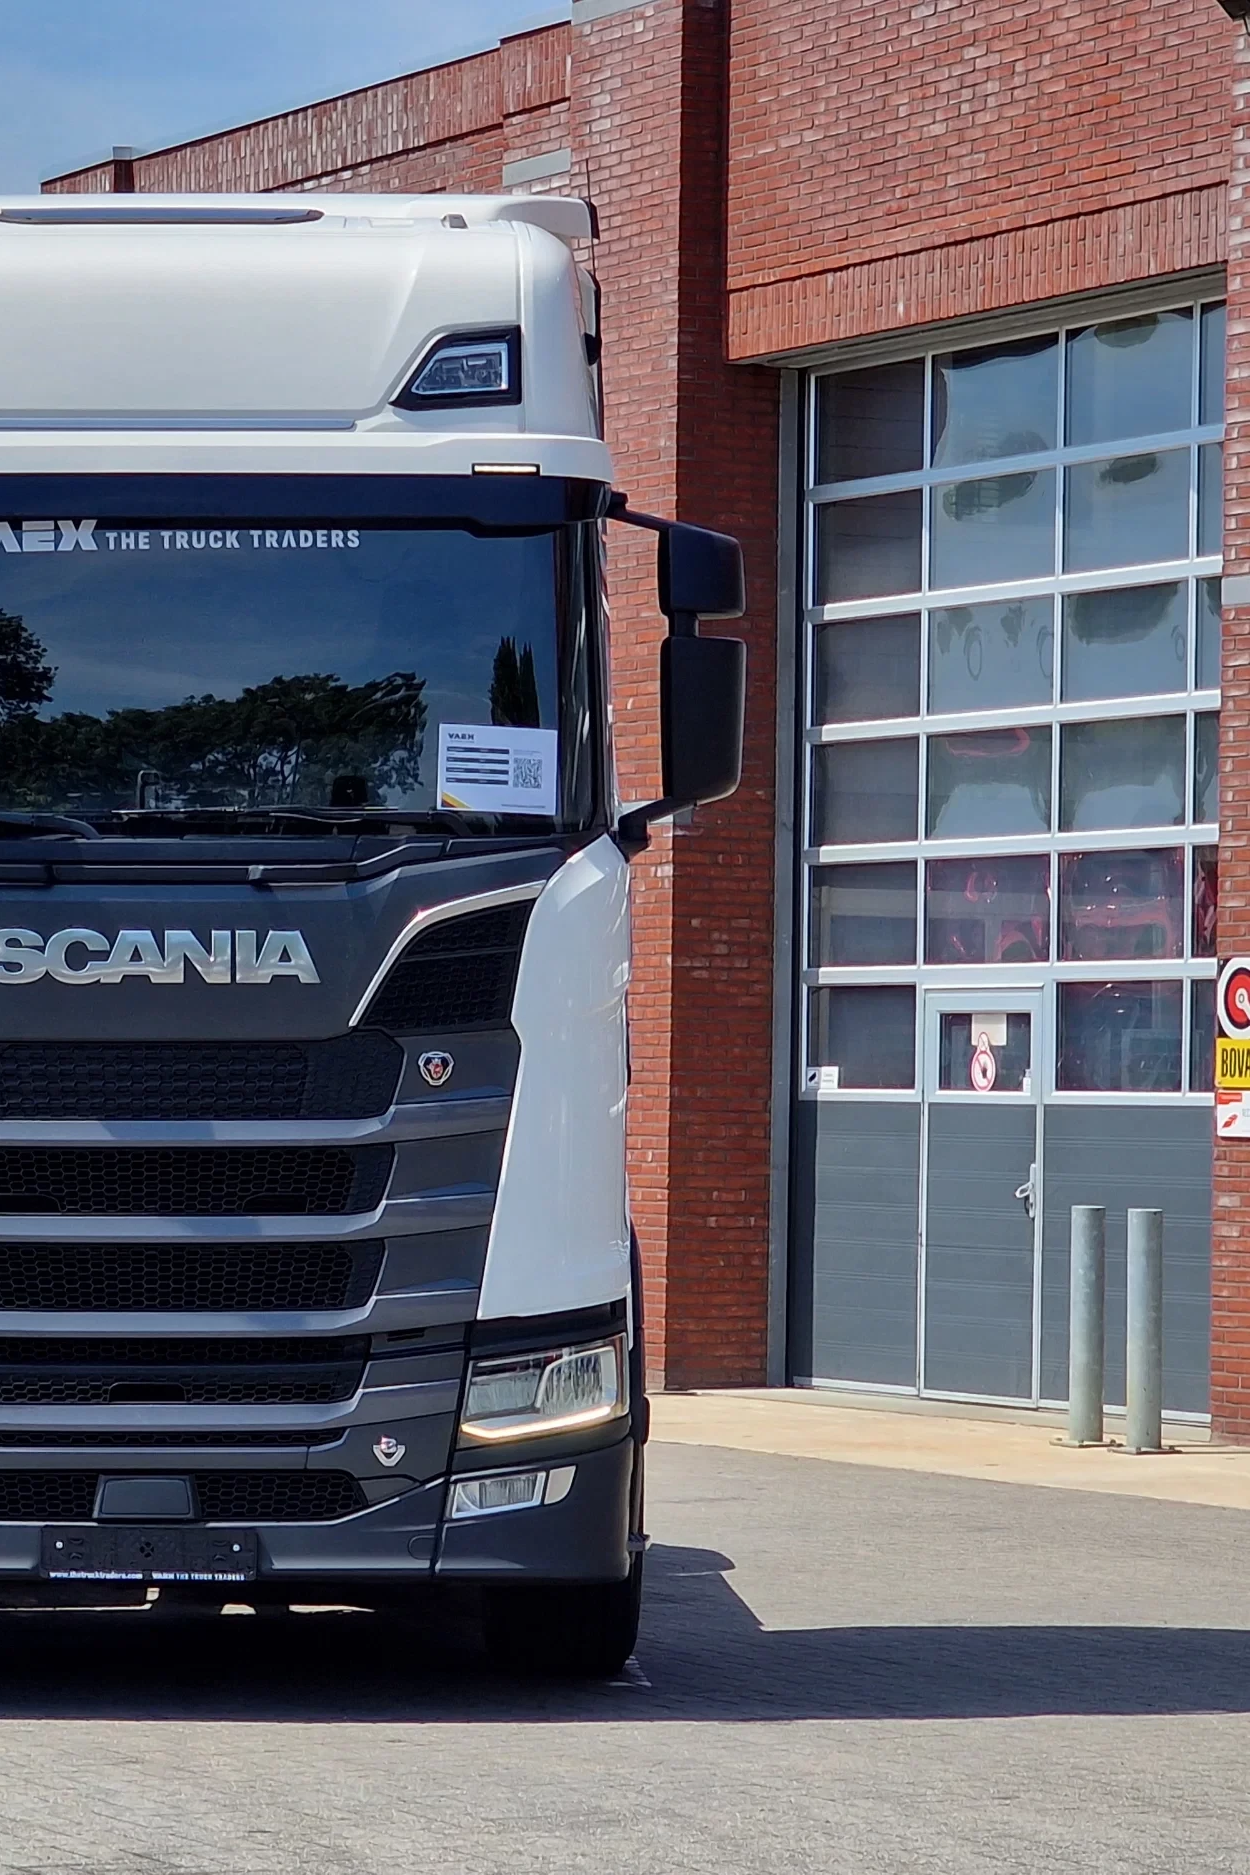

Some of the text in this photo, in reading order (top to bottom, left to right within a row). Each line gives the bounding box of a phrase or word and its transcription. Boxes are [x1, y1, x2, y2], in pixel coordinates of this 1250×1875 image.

[105, 531, 150, 550] THE
[161, 529, 240, 549] TRUCK
[250, 529, 360, 548] TRADERS
